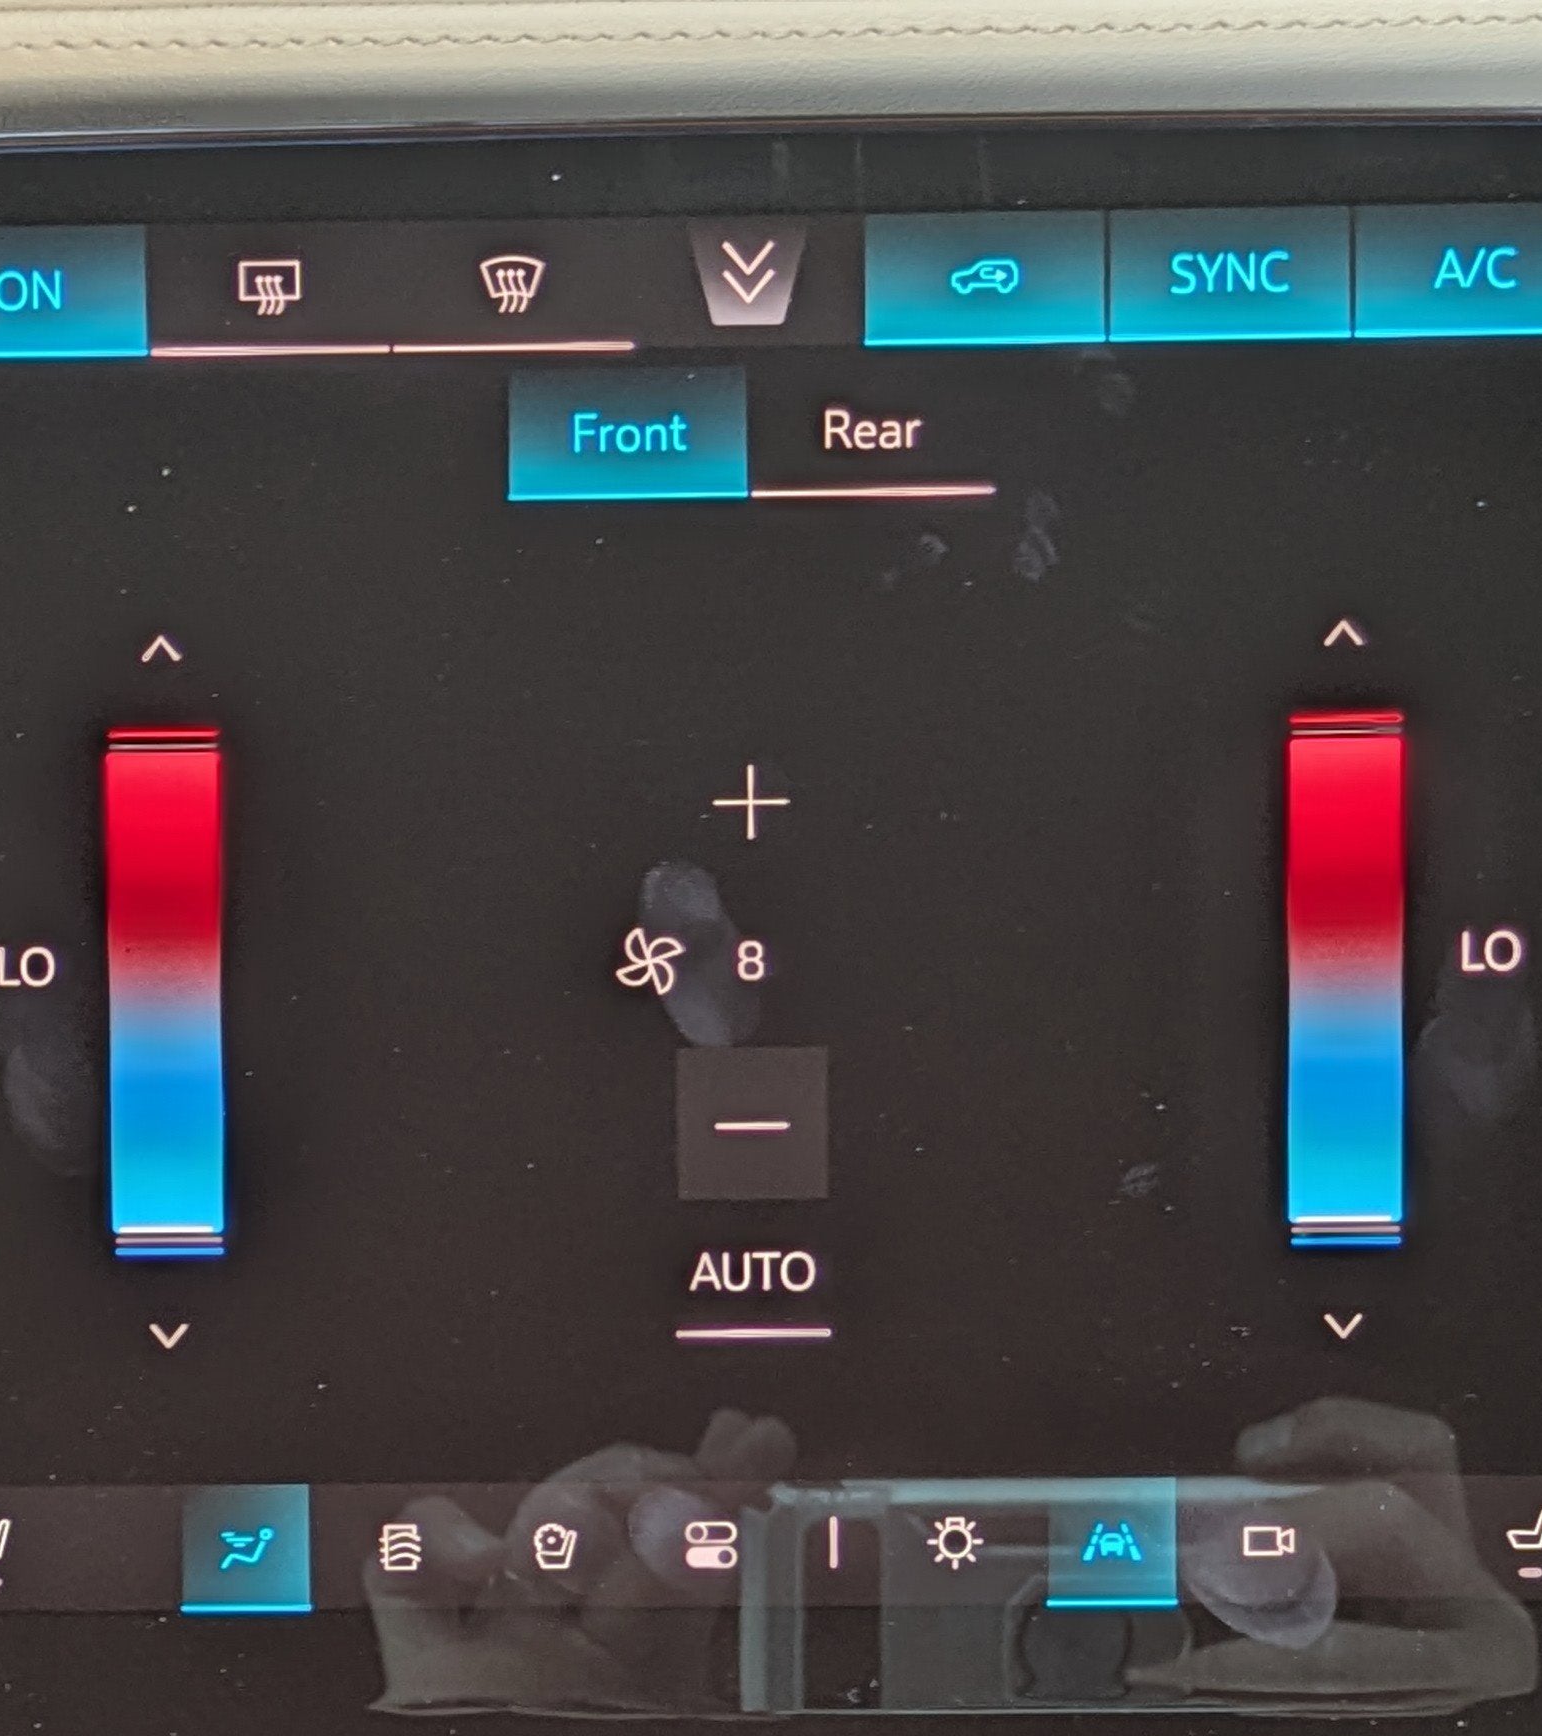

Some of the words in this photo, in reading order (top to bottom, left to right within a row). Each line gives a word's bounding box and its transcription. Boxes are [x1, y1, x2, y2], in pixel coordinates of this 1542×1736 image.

[1169, 251, 1291, 296] SYNC
[1433, 247, 1517, 291] A/C
[572, 412, 688, 454] Front
[823, 408, 922, 450] Rear
[736, 940, 766, 981] 8
[1460, 930, 1522, 972] LO
[689, 1250, 817, 1292] AUTO
